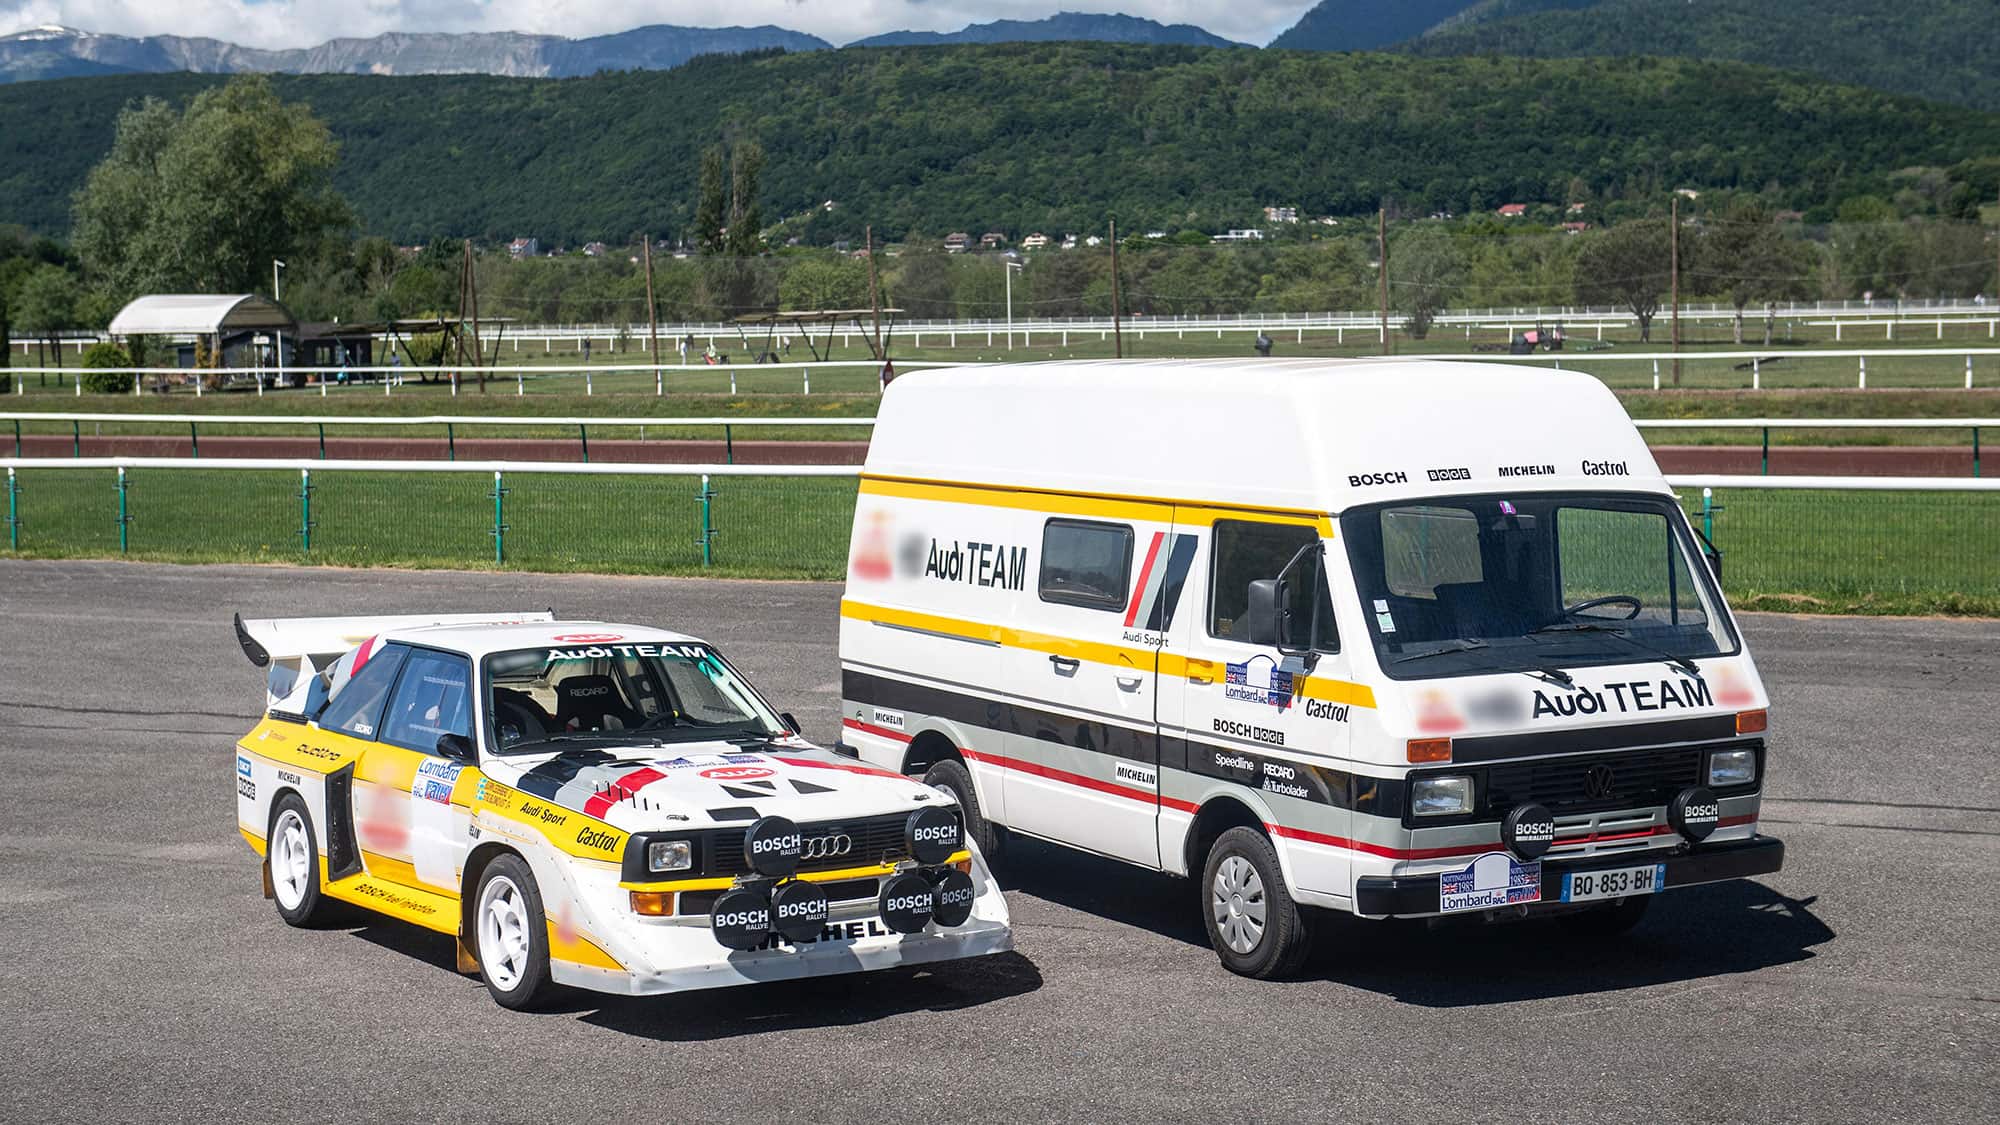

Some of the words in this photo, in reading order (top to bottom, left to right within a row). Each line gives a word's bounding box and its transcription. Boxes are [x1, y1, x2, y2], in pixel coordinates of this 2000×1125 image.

[1427, 468, 1472, 482] BOGE
[1498, 465, 1555, 478] MICHELIN
[1581, 460, 1630, 476] Castrol
[1348, 471, 1409, 488] BOSCH
[1122, 631, 1142, 643] Audi
[1143, 633, 1169, 648] Sport
[569, 686, 609, 697] RECARO
[1225, 684, 1259, 701] Lombard
[874, 710, 904, 727] MICHELIN
[1305, 698, 1350, 723] Castrol
[1213, 718, 1252, 738] BOSCH
[1253, 726, 1285, 745] BOGE
[418, 759, 460, 782] Lombard
[1215, 753, 1255, 771] Speedline
[277, 768, 301, 786] MICHELIN
[1116, 766, 1156, 785] MICHELIN
[1263, 763, 1296, 781] RECARO
[1271, 780, 1309, 798] Turbolader
[520, 801, 543, 817] Audi
[541, 808, 567, 826] Sport
[1684, 804, 1719, 817] BOSCH
[914, 825, 957, 841] BOSCH
[1515, 822, 1554, 835] BOSCH
[575, 826, 621, 853] Castrol
[752, 834, 801, 854] BOSCH
[780, 847, 801, 857] RALLYE
[1442, 872, 1474, 884] NOTTINGHAM
[1573, 868, 1653, 897] BQ-853-BH
[942, 887, 974, 905] BOSCH
[1458, 881, 1474, 894] 1985
[778, 899, 828, 918] BOSCH
[887, 893, 933, 911] BOSCH
[1442, 891, 1492, 910] Lombard
[1492, 896, 1506, 906] RAC
[715, 909, 769, 927] BOSCH
[805, 912, 828, 921] RALLYE
[745, 922, 769, 931] RALLYE
